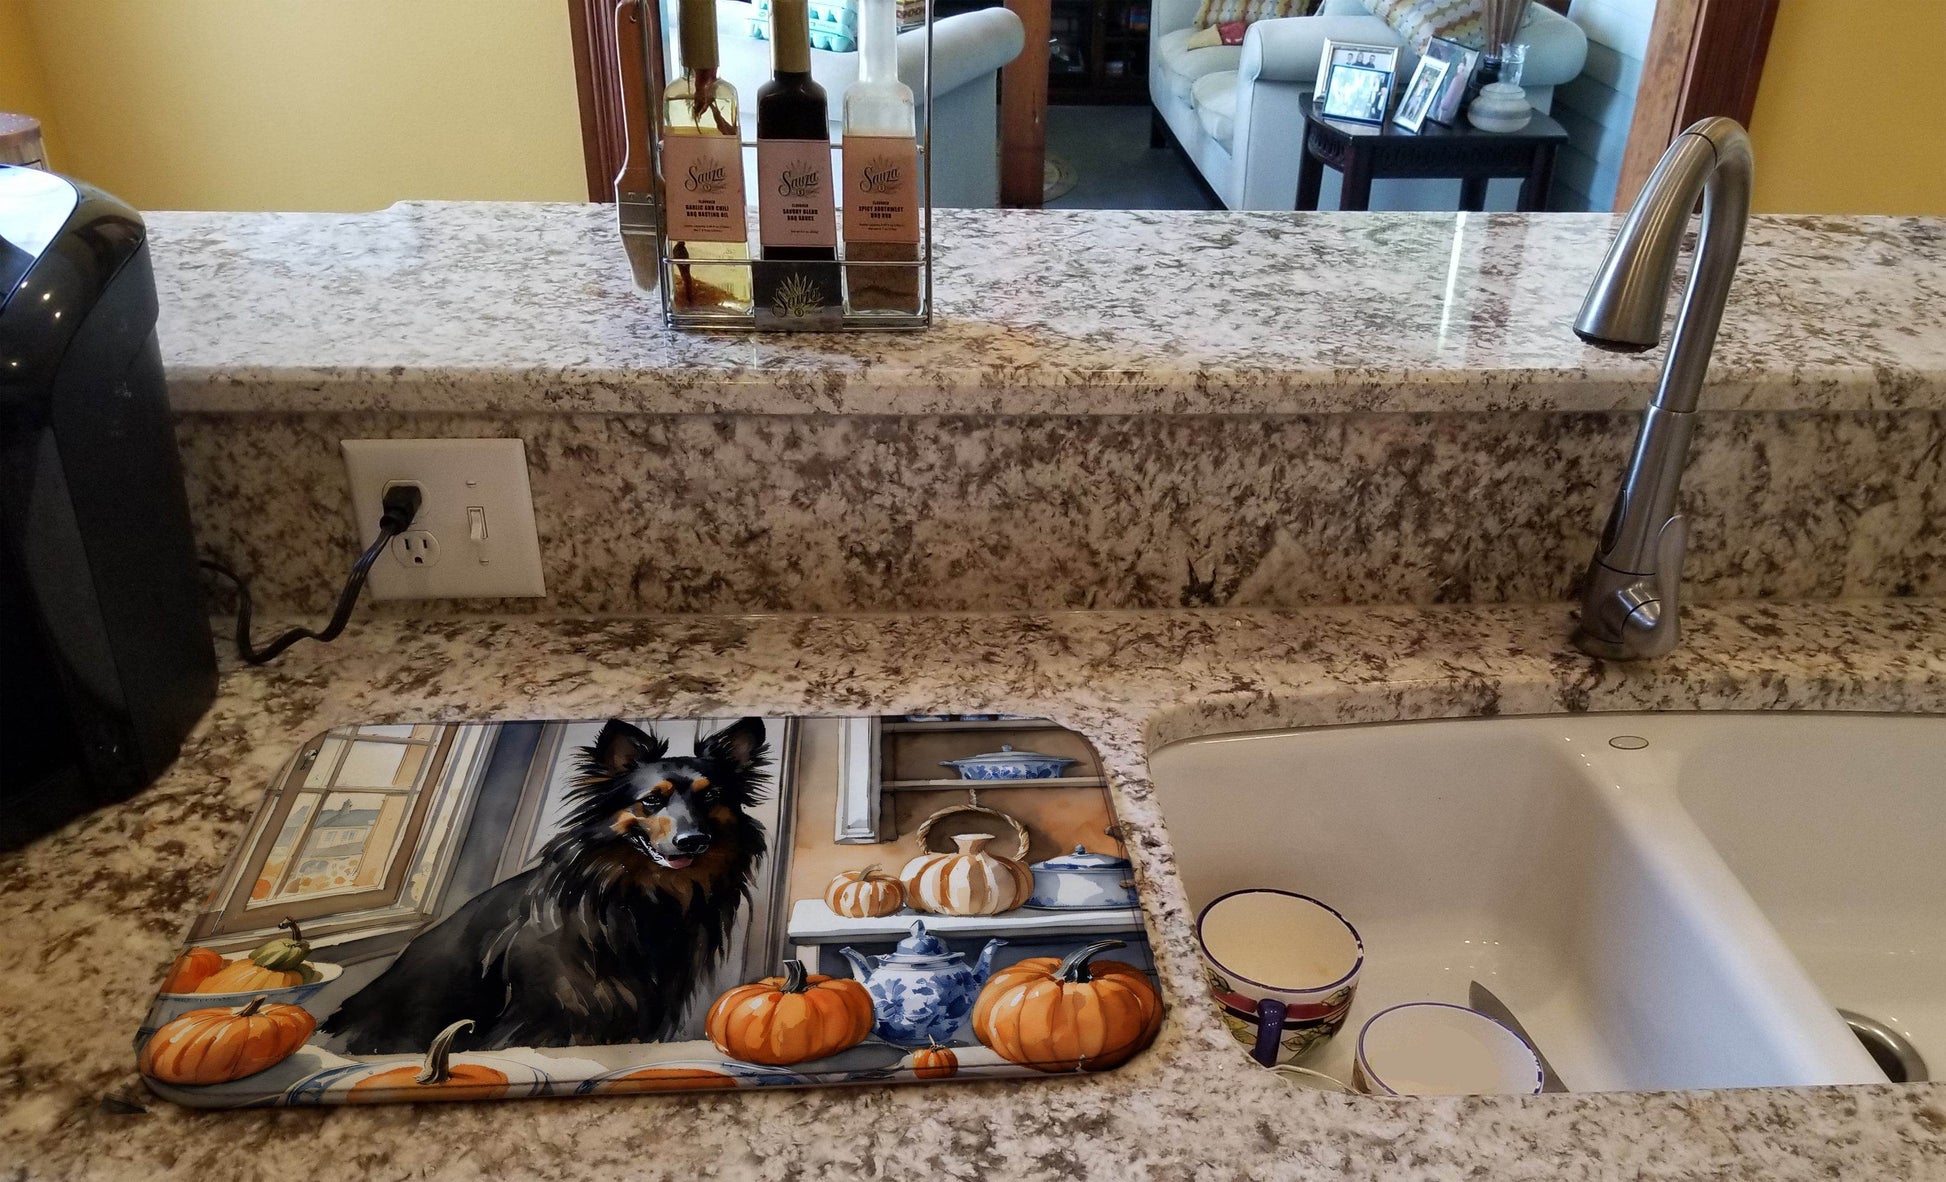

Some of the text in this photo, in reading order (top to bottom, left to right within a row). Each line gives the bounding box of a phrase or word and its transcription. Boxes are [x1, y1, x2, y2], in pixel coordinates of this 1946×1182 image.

[685, 166, 726, 191] Sauza
[778, 171, 820, 197] Sauza
[859, 167, 900, 192] Sauza
[771, 287, 821, 317] Sauza
